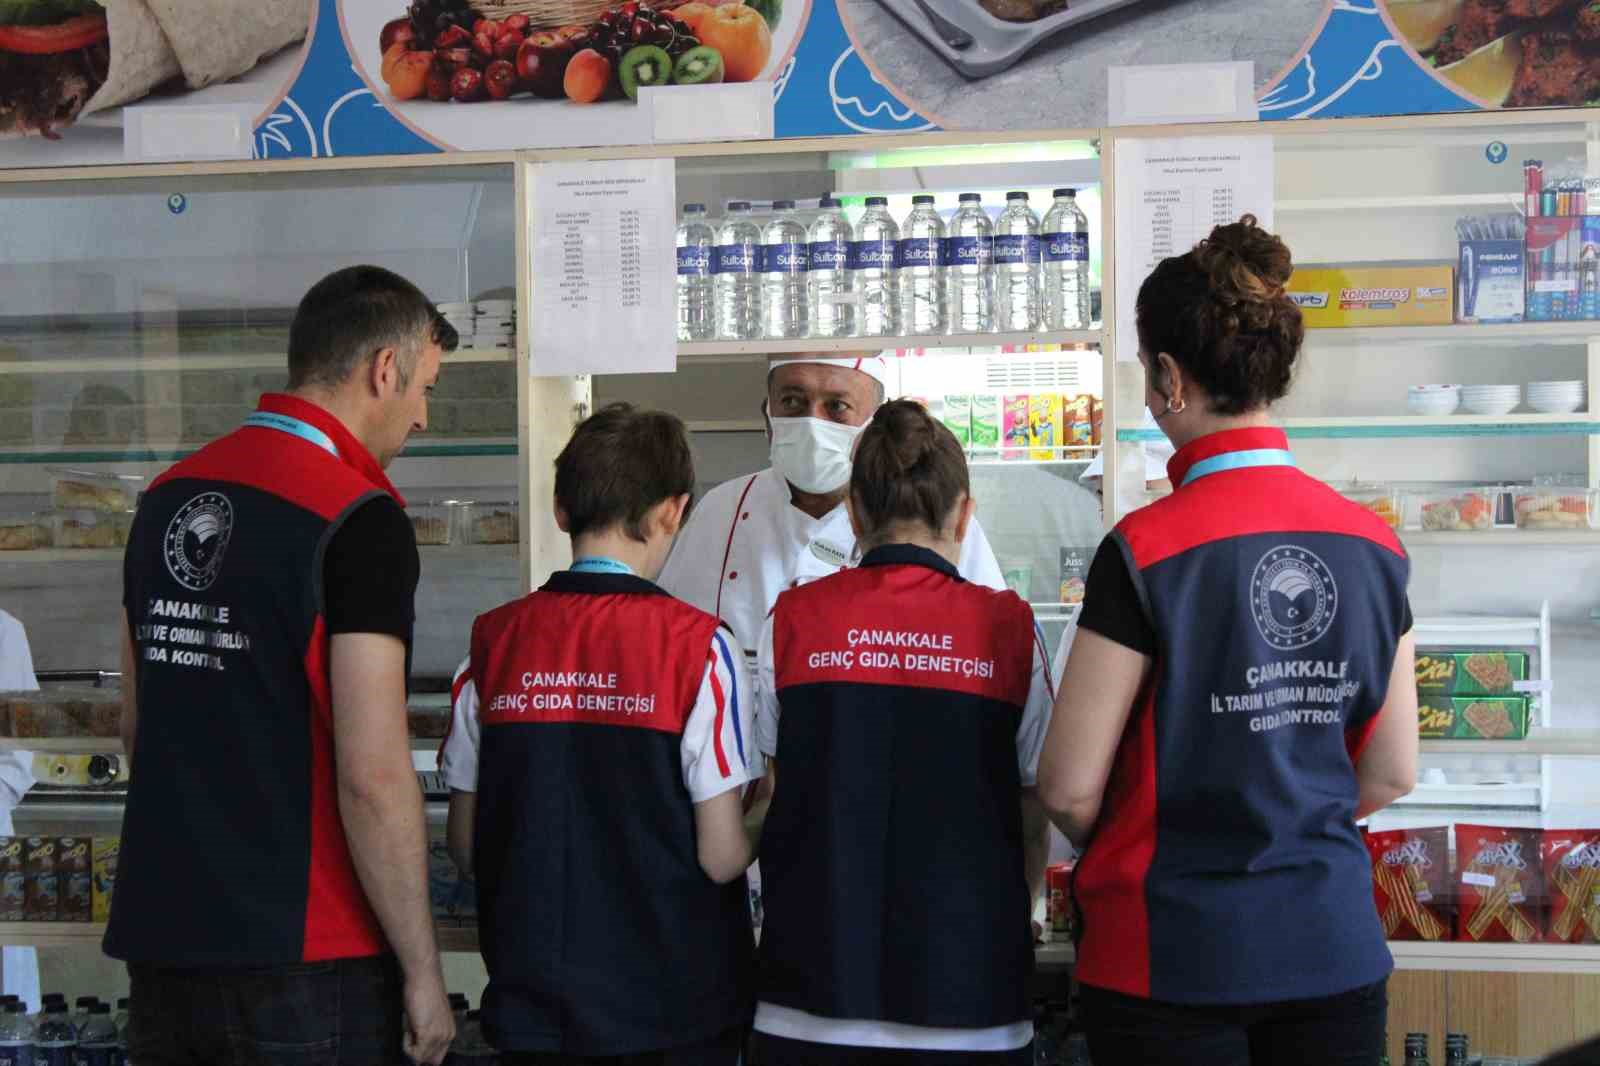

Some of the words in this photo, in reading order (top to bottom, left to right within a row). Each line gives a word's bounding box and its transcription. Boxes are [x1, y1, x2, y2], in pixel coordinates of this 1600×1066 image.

[152, 624, 168, 641] VE
[847, 629, 953, 650] ÇANAKKALE
[808, 651, 854, 669] GENÇ
[859, 652, 900, 668] GIDA
[904, 654, 994, 678] DENETÇİSİ
[521, 672, 617, 690] ÇANAKKALE
[533, 694, 574, 709] GIDA
[577, 693, 656, 715] DENETÇİSİ
[1211, 692, 1224, 712] İL
[1225, 693, 1263, 711] TARIM
